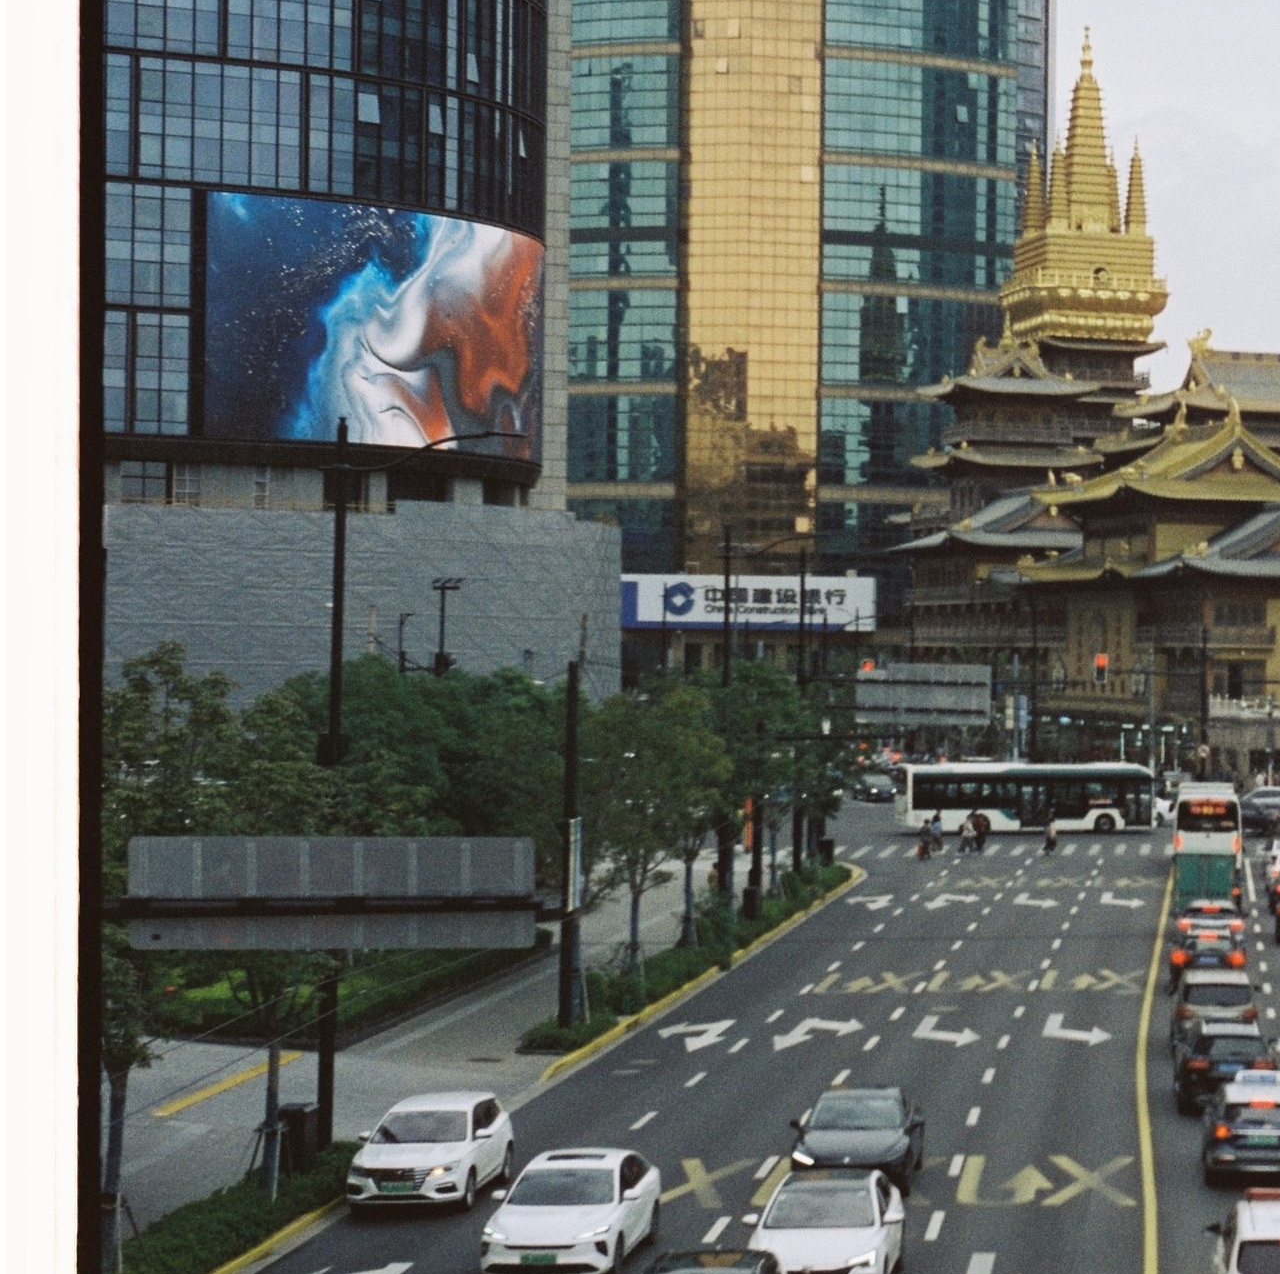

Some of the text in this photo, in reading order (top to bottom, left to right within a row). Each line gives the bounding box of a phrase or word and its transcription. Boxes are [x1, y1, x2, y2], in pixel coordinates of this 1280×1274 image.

[704, 588, 846, 605] 中国建设银行
[739, 605, 800, 615] Construction
